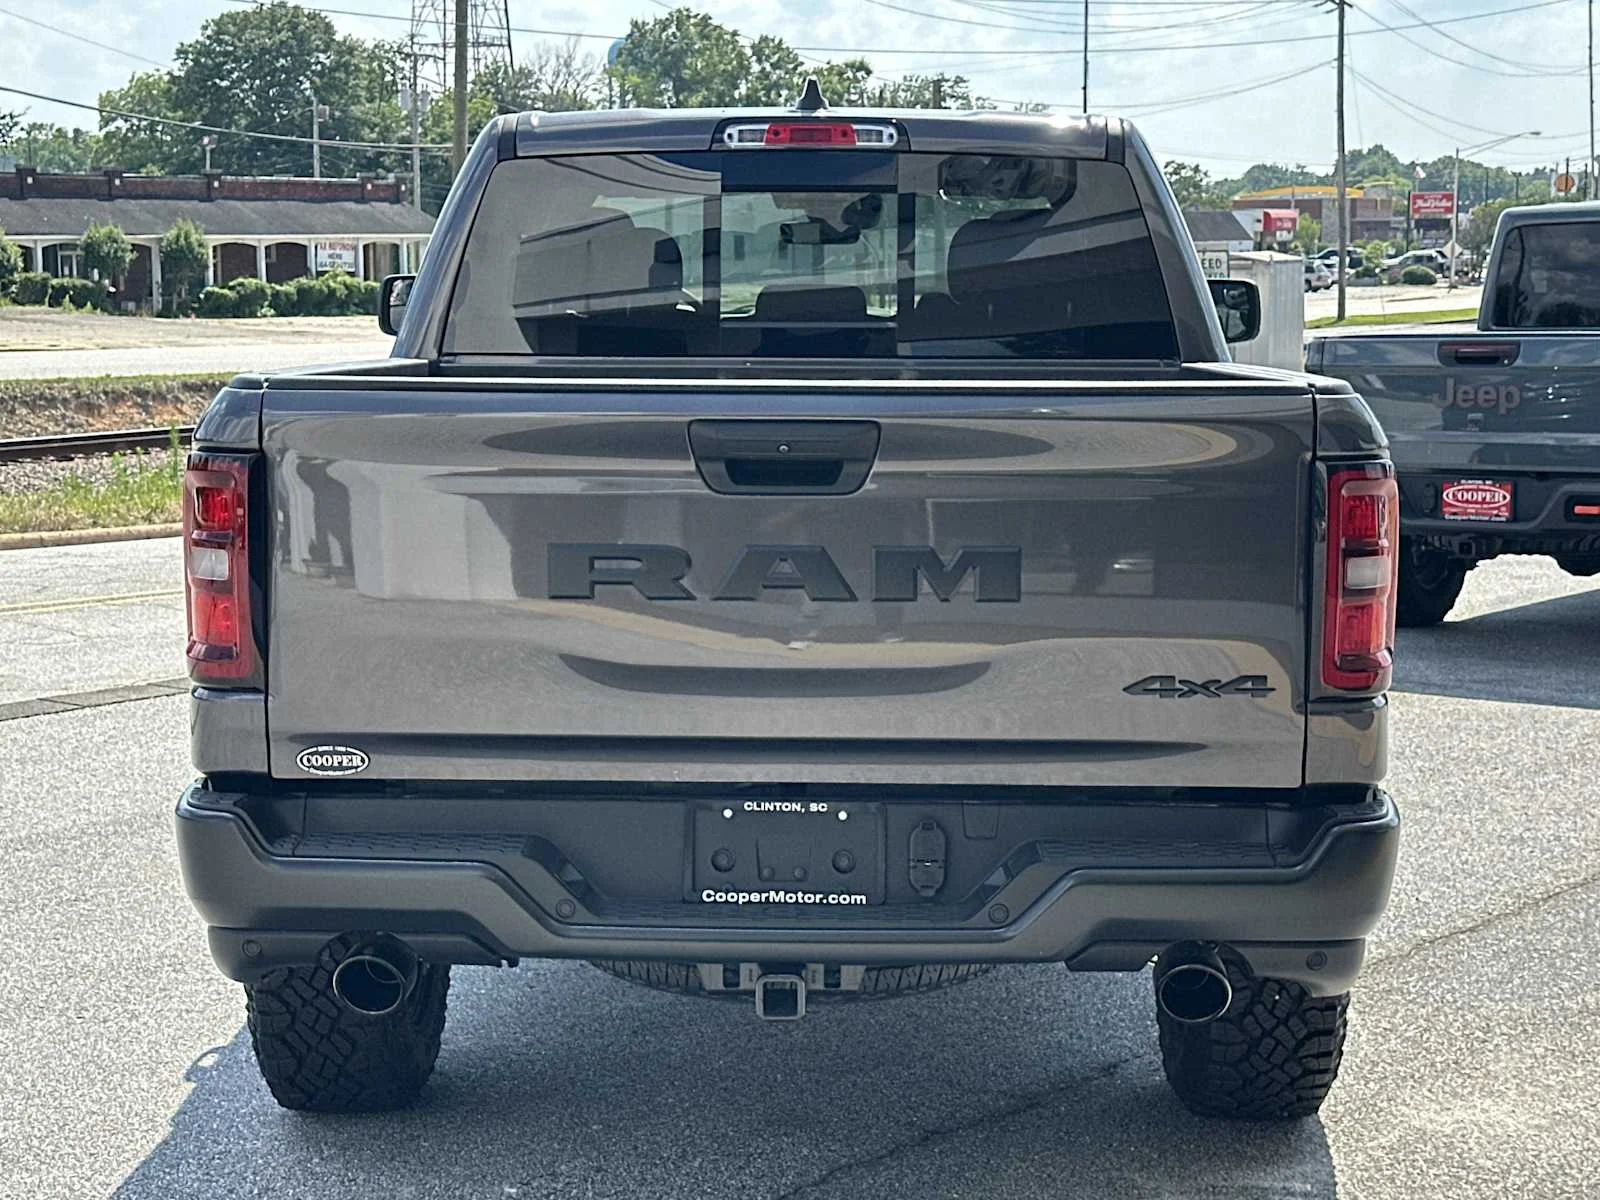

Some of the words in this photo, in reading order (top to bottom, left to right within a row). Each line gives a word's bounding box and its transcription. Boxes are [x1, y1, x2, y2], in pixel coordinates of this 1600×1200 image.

[1201, 258, 1222, 270] EED
[1432, 378, 1520, 415] Jeep
[1447, 490, 1504, 502] COOPER
[548, 543, 1022, 602] RAM
[302, 754, 363, 767] COOPER
[743, 801, 805, 813] CLINTON,
[809, 802, 828, 812] SC
[701, 889, 867, 905] CooperMotor.com
